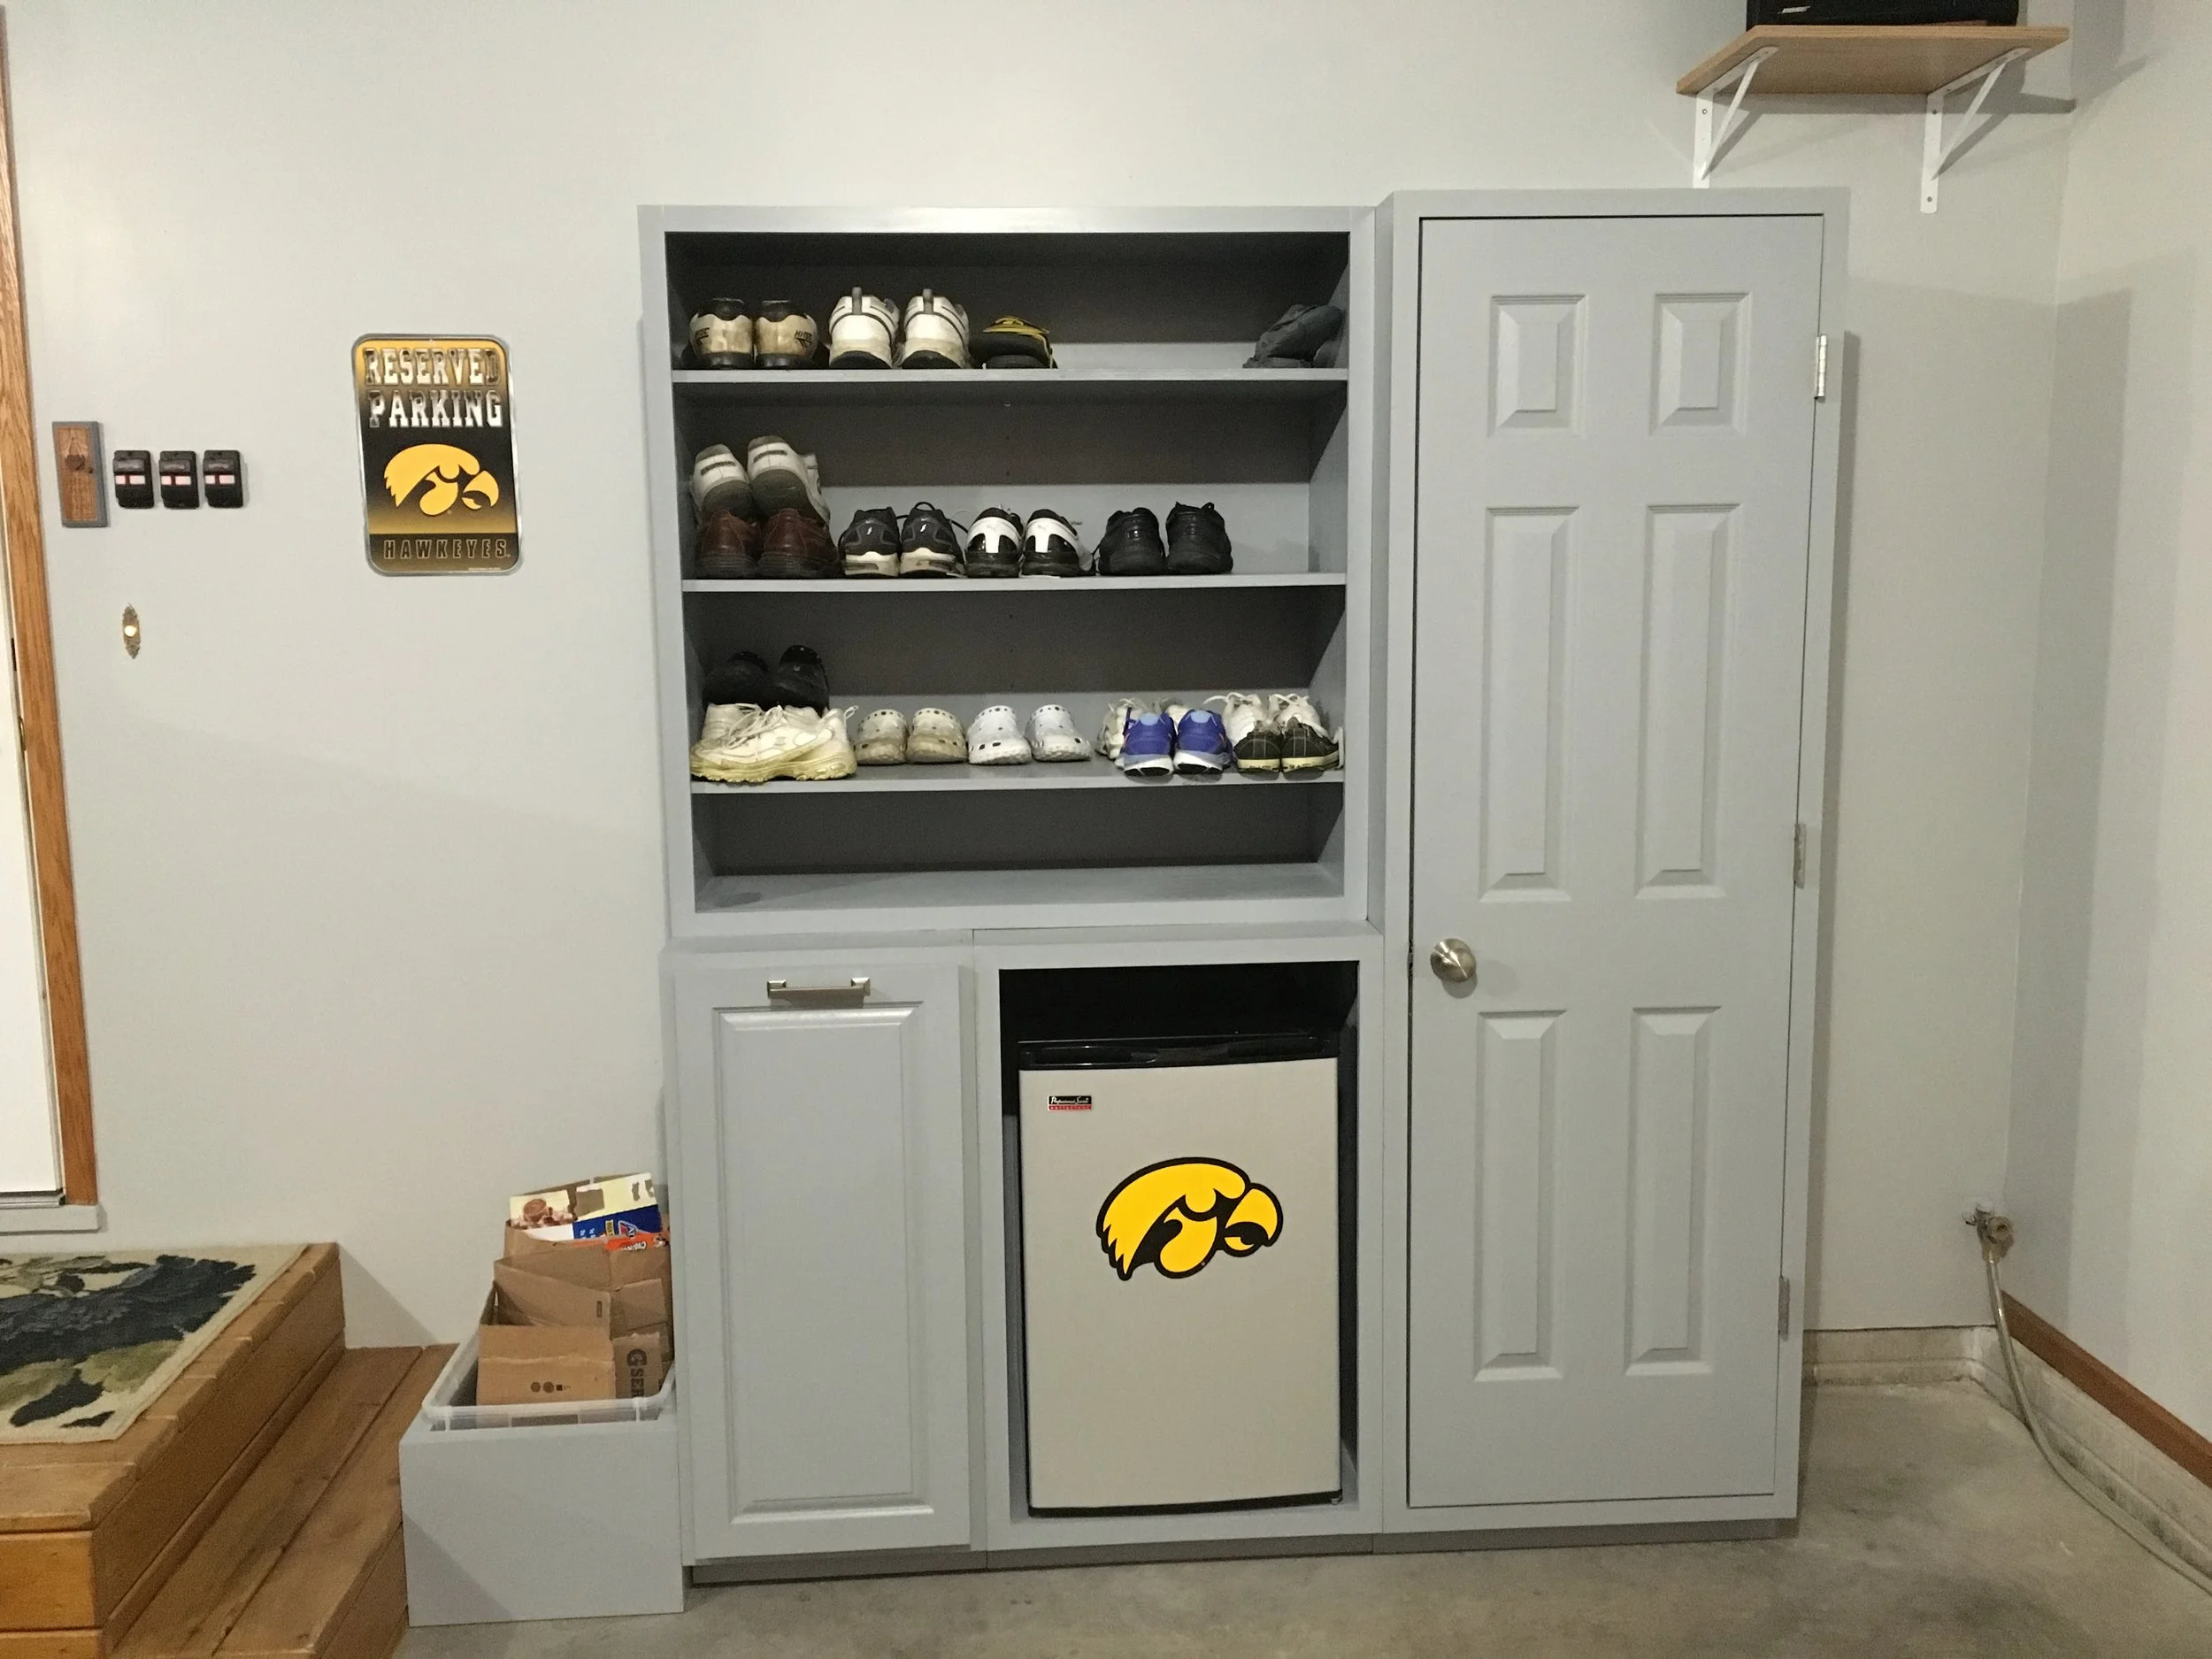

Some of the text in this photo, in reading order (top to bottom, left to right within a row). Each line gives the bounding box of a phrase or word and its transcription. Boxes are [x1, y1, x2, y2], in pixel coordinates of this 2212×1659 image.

[363, 348, 501, 386] RESERVED
[368, 389, 503, 428] PARKING
[383, 538, 507, 559] HAWKEYES
